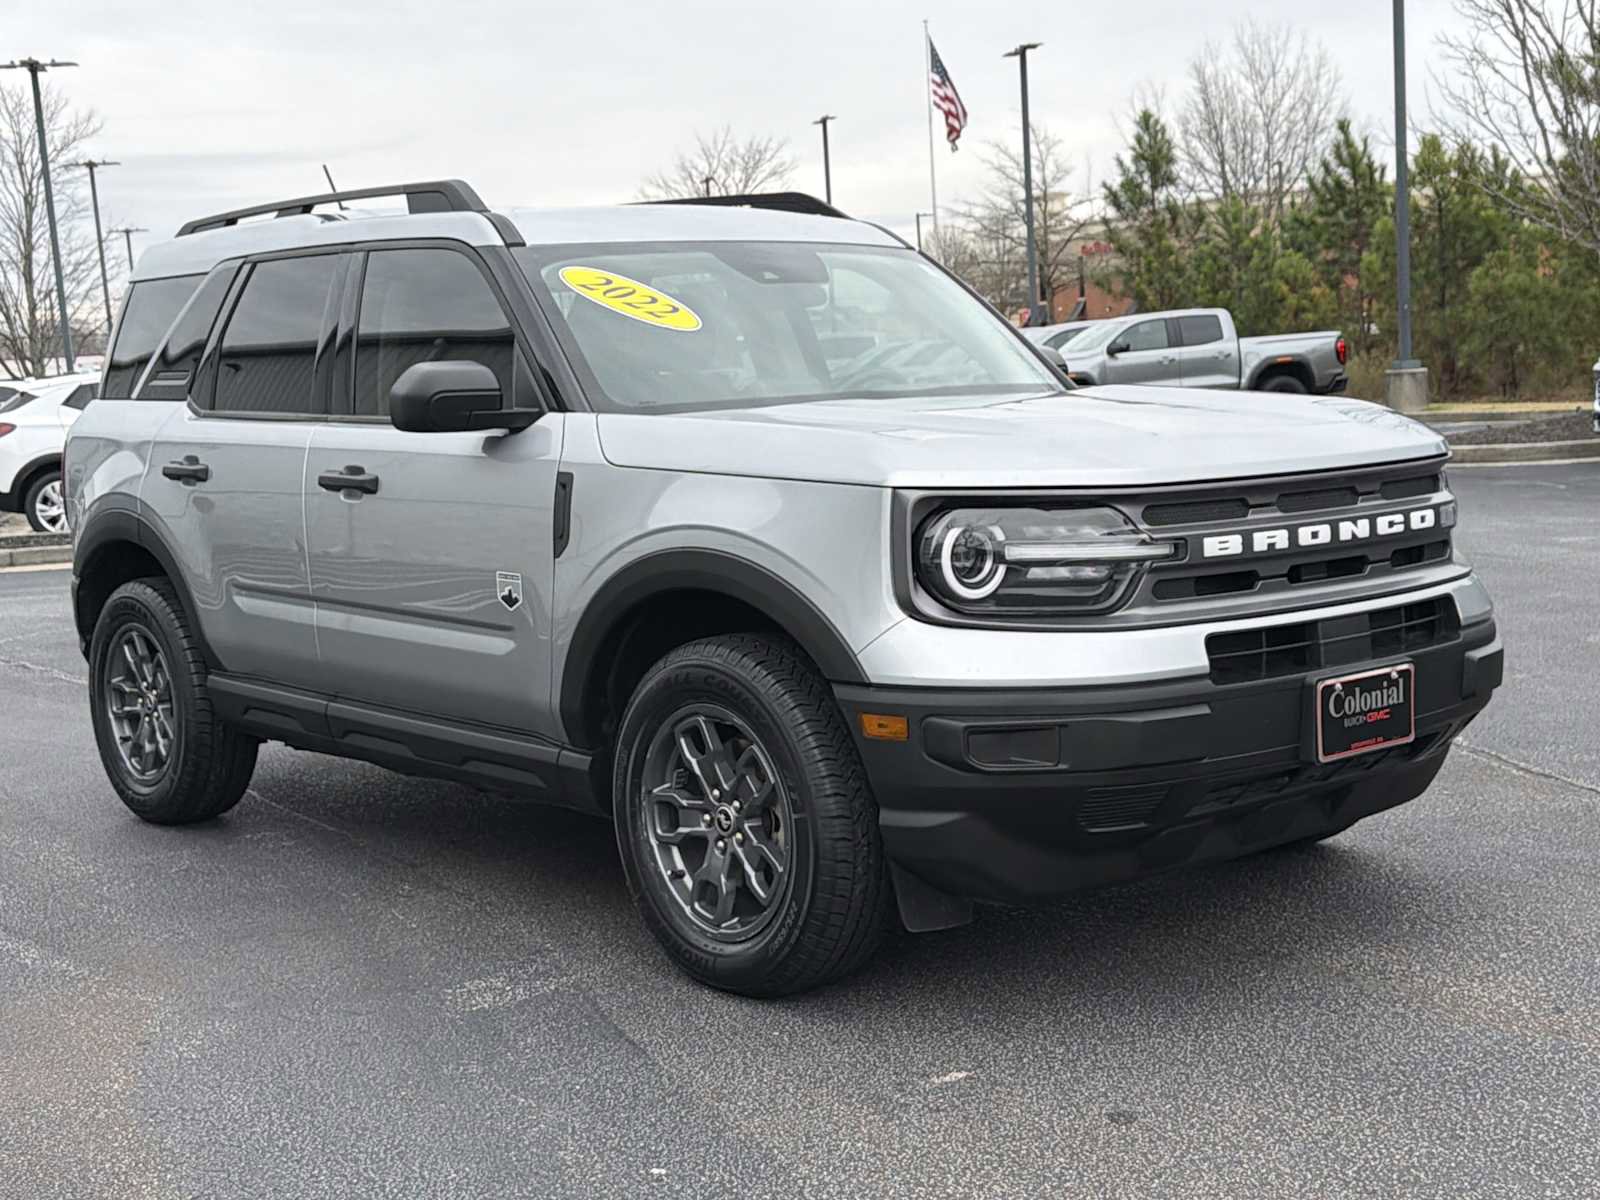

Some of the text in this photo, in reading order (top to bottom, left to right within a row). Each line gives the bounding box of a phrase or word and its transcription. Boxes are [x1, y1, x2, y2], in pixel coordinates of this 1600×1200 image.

[576, 276, 680, 319] 2022
[1203, 508, 1435, 557] BRONCO
[1329, 678, 1404, 717] Colonial
[1367, 708, 1391, 723] GMC
